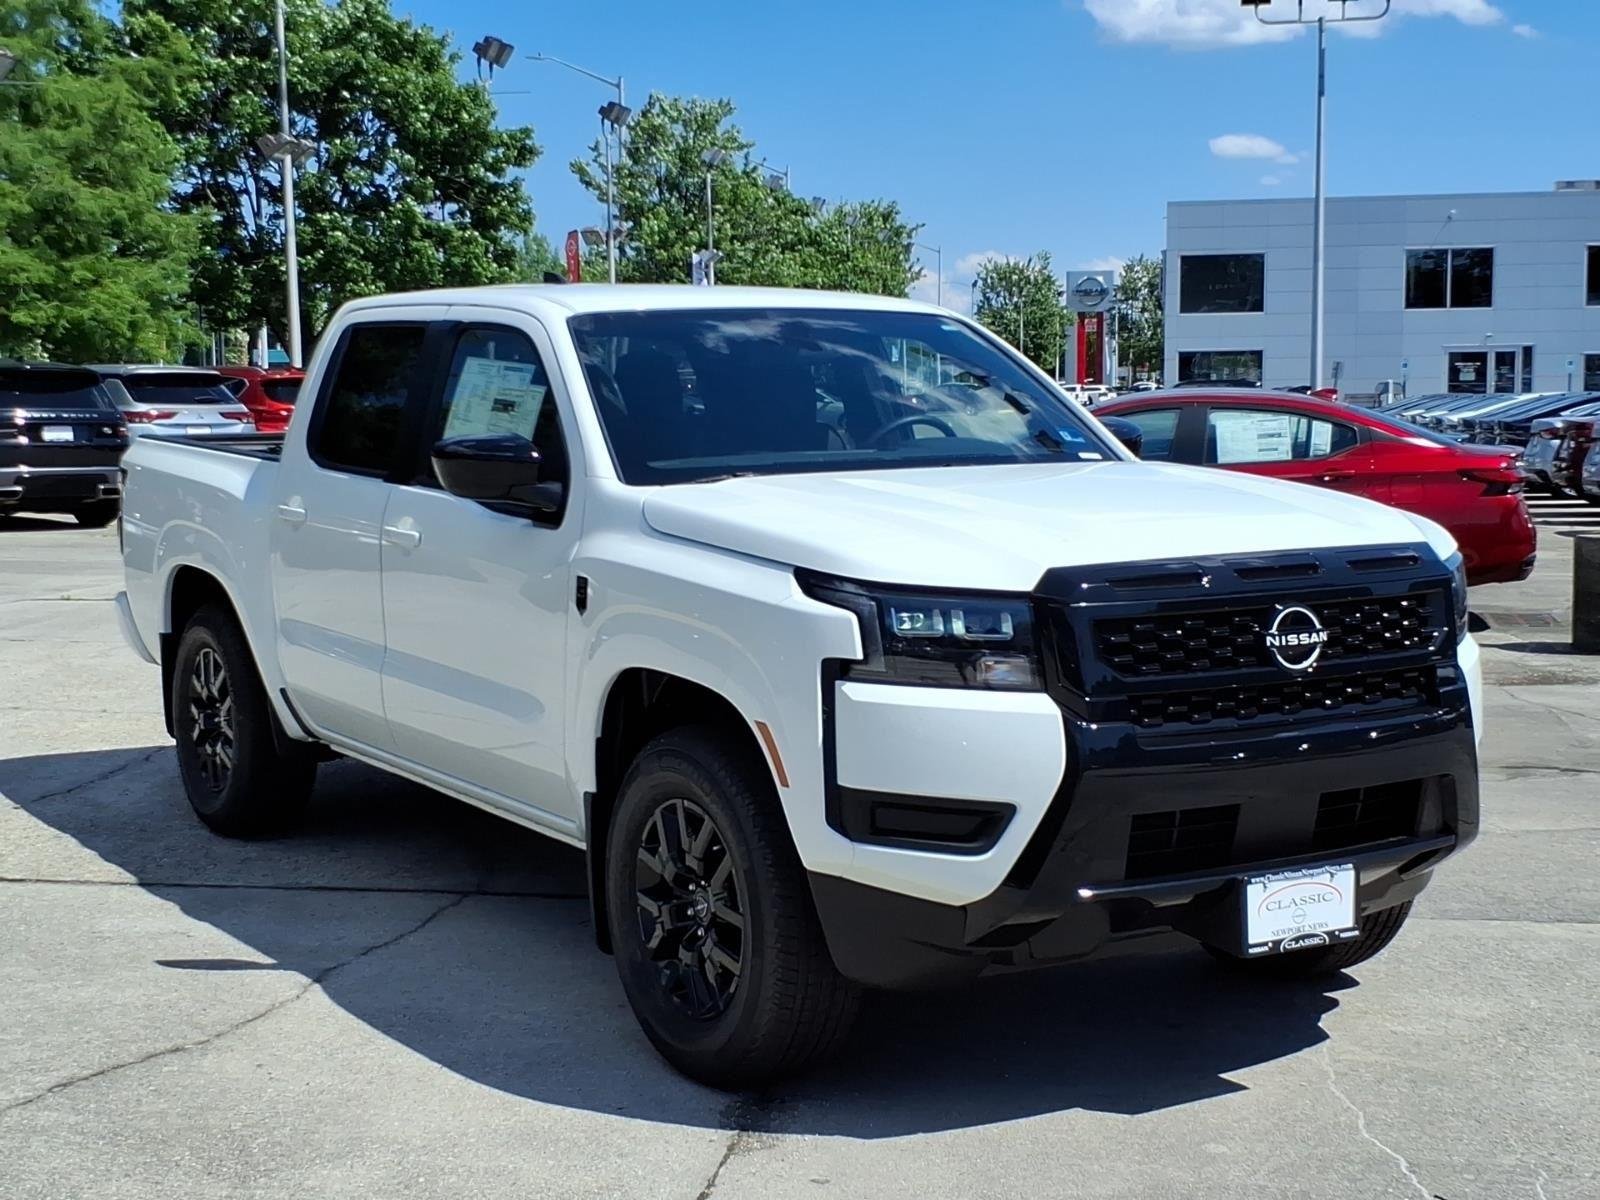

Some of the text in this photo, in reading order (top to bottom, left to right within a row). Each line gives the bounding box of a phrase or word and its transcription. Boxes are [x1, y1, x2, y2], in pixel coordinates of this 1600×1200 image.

[1266, 631, 1328, 646] NISSAN
[1265, 891, 1334, 912] CLASSIC
[1271, 922, 1329, 937] NEWPORT NEWS
[1284, 936, 1324, 949] CLASSIC
